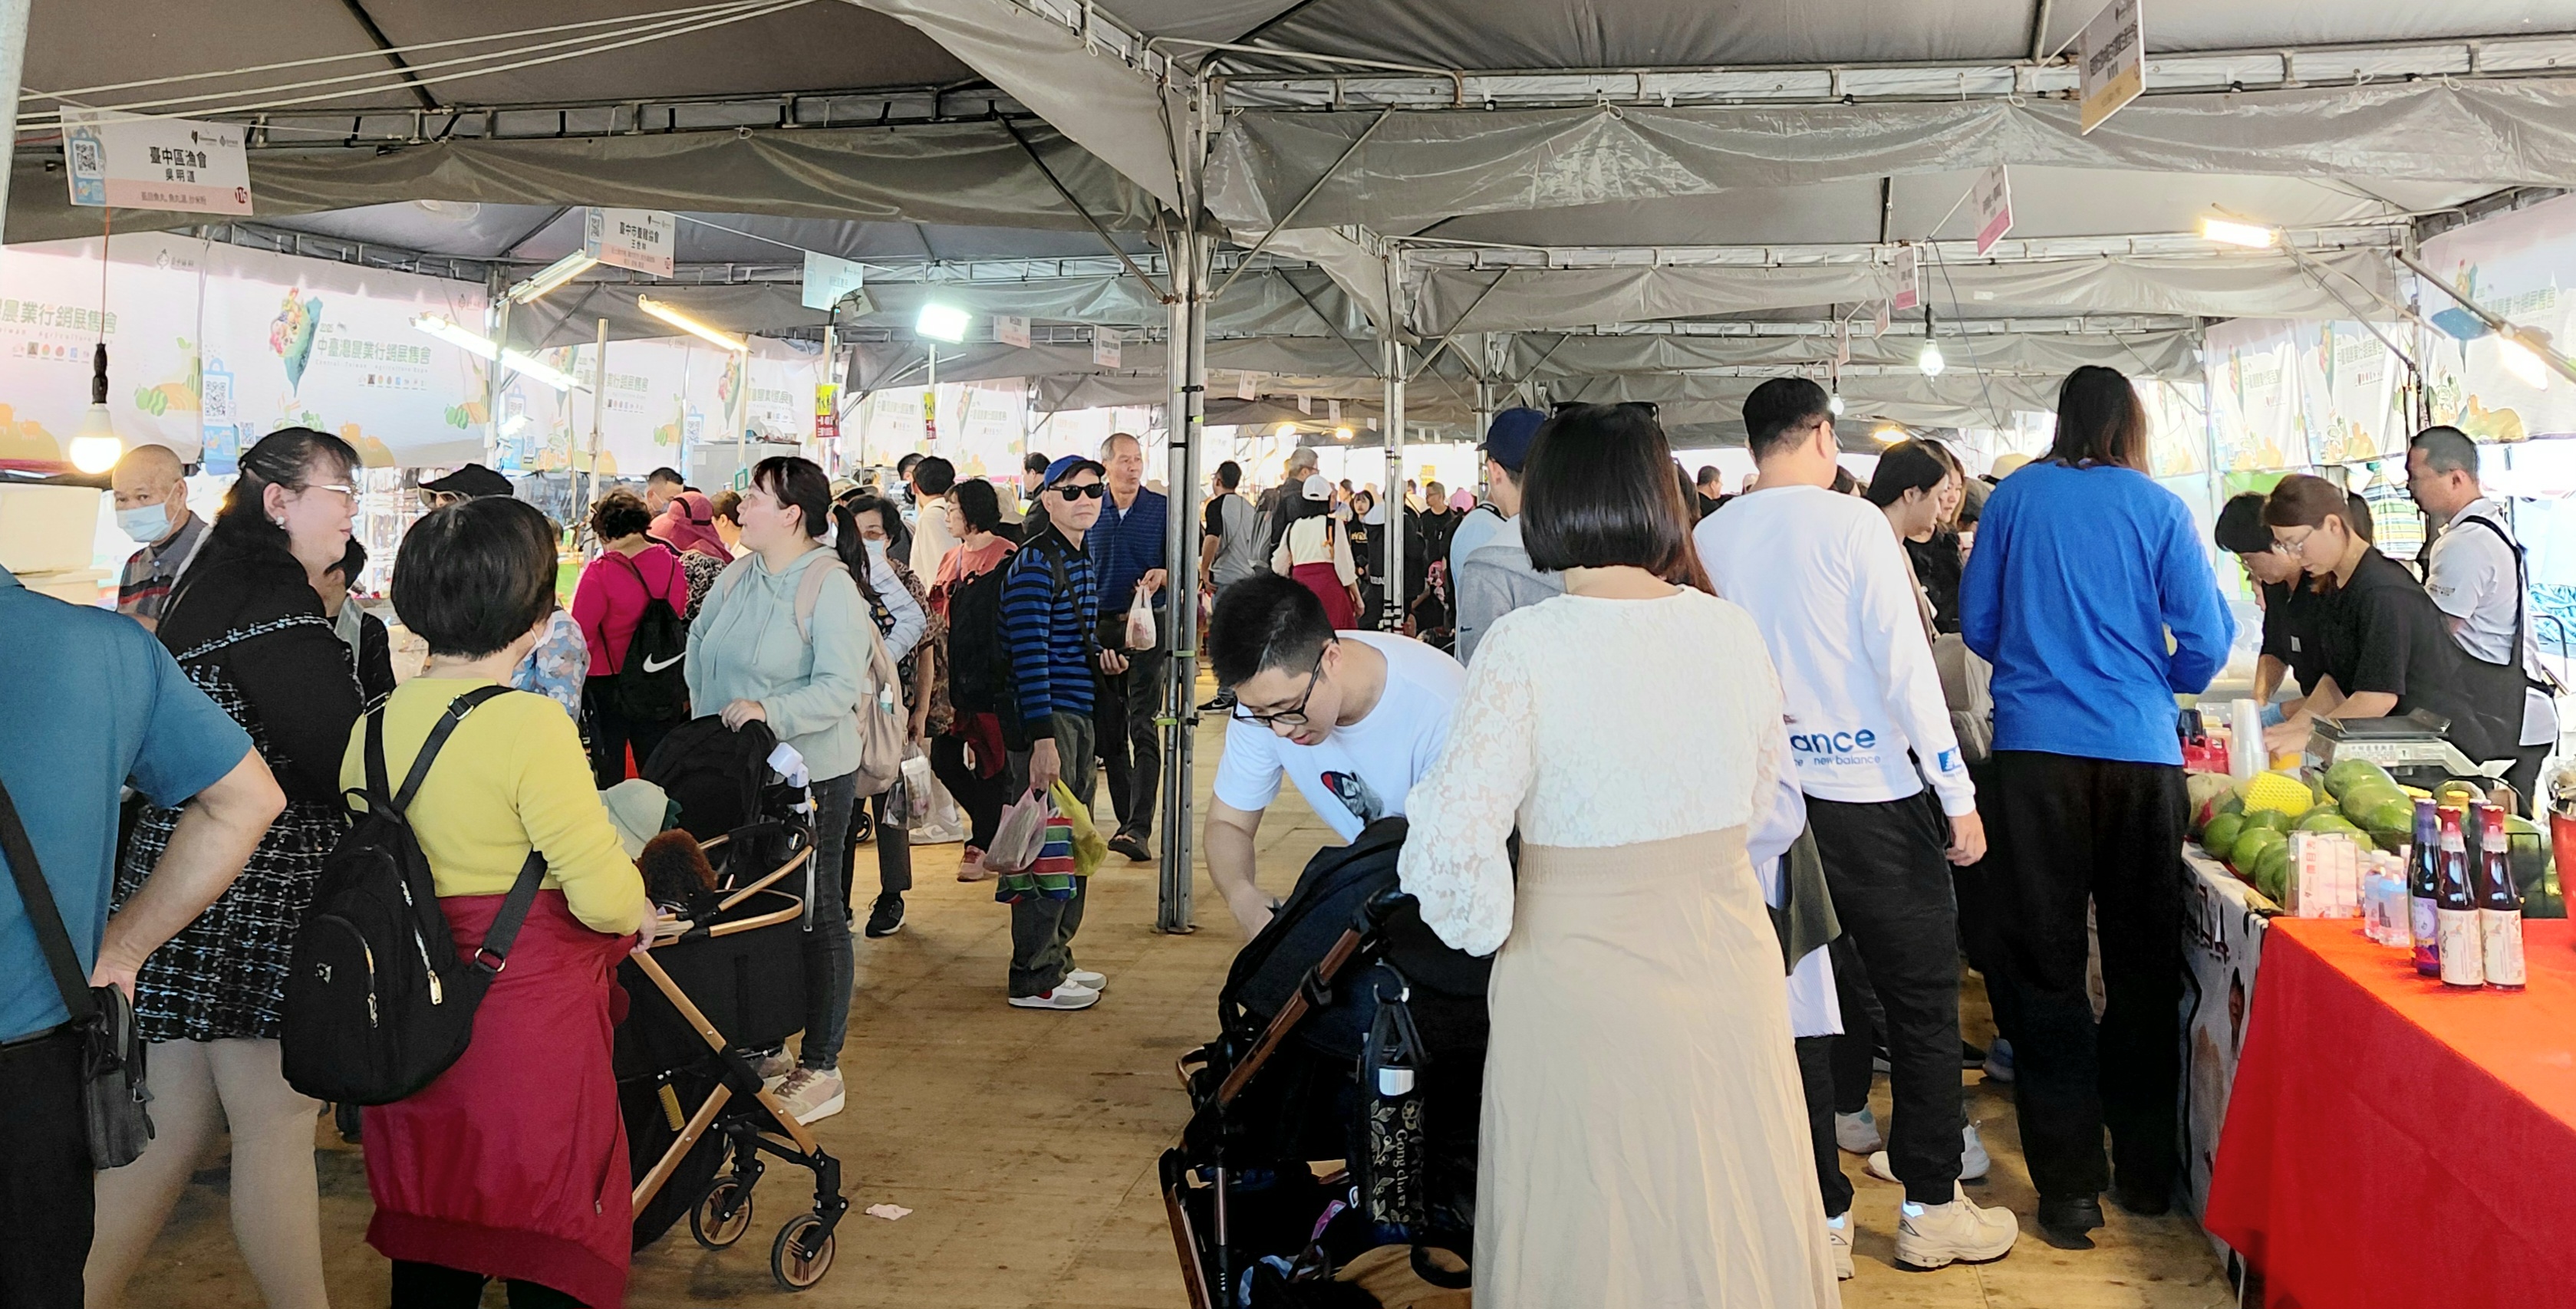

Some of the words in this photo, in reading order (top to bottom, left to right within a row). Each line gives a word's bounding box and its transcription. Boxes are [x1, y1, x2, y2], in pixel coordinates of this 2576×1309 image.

[149, 146, 207, 169] 臺中區漁會
[0, 298, 117, 334] 農業行銷展售會
[1813, 756, 1834, 765] new
[1835, 755, 1881, 765] balance
[1393, 1129, 1408, 1168] Gong
